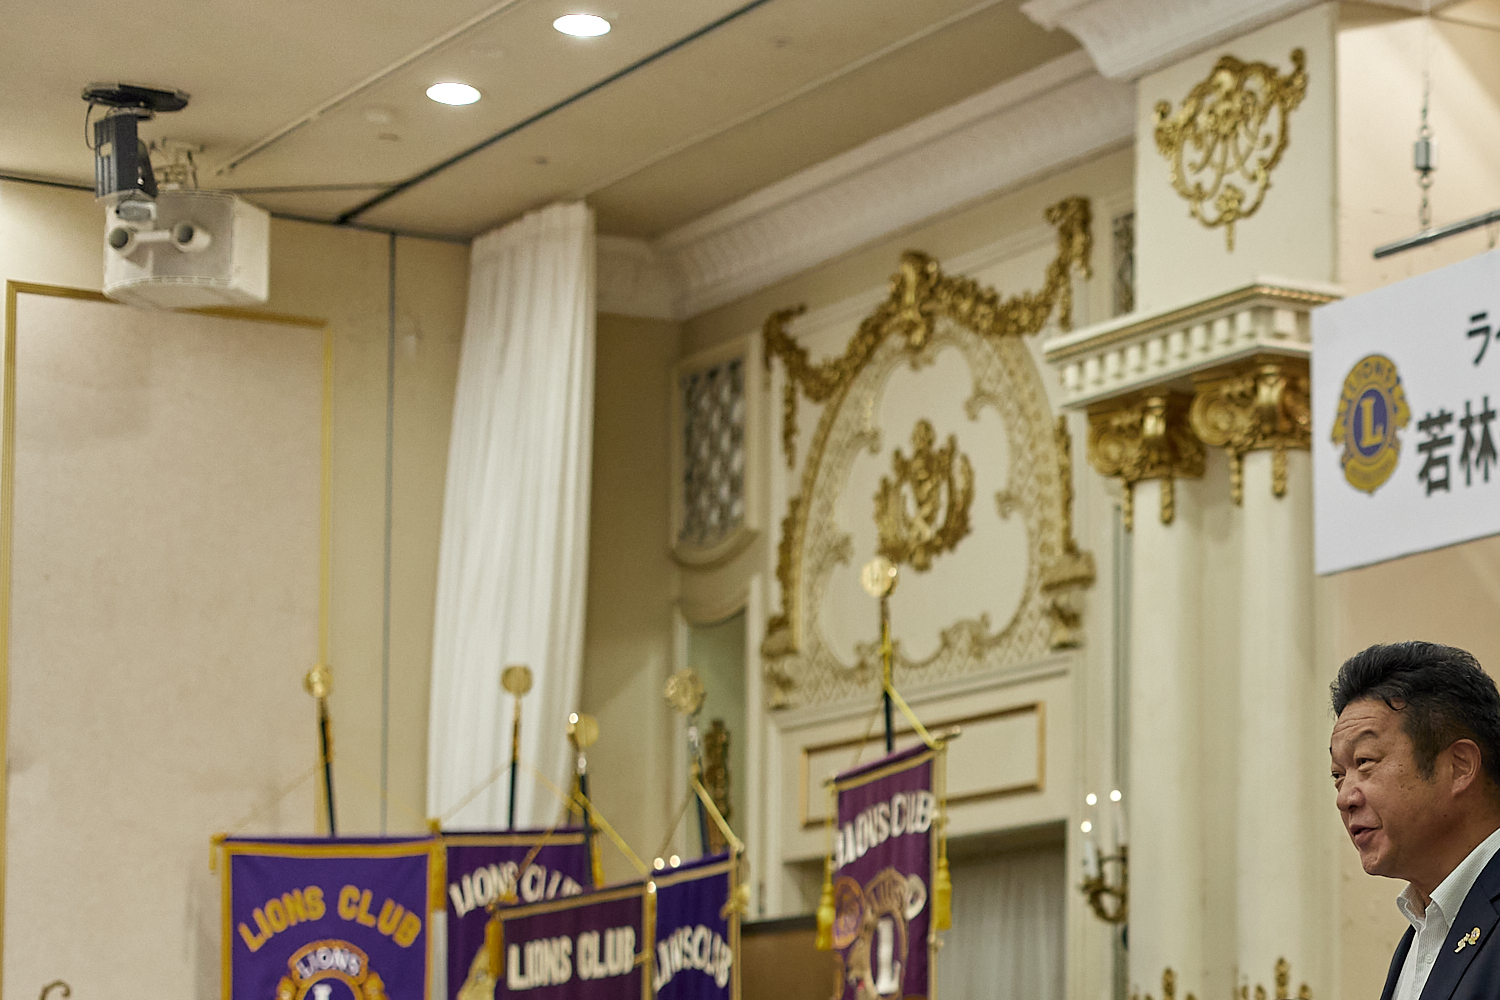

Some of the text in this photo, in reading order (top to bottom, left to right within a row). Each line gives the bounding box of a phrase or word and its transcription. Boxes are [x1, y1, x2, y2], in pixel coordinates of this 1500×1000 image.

[238, 884, 422, 952] LIONS CLUB
[296, 947, 361, 979] LIONS
[507, 925, 636, 990] LIONS CLUB
